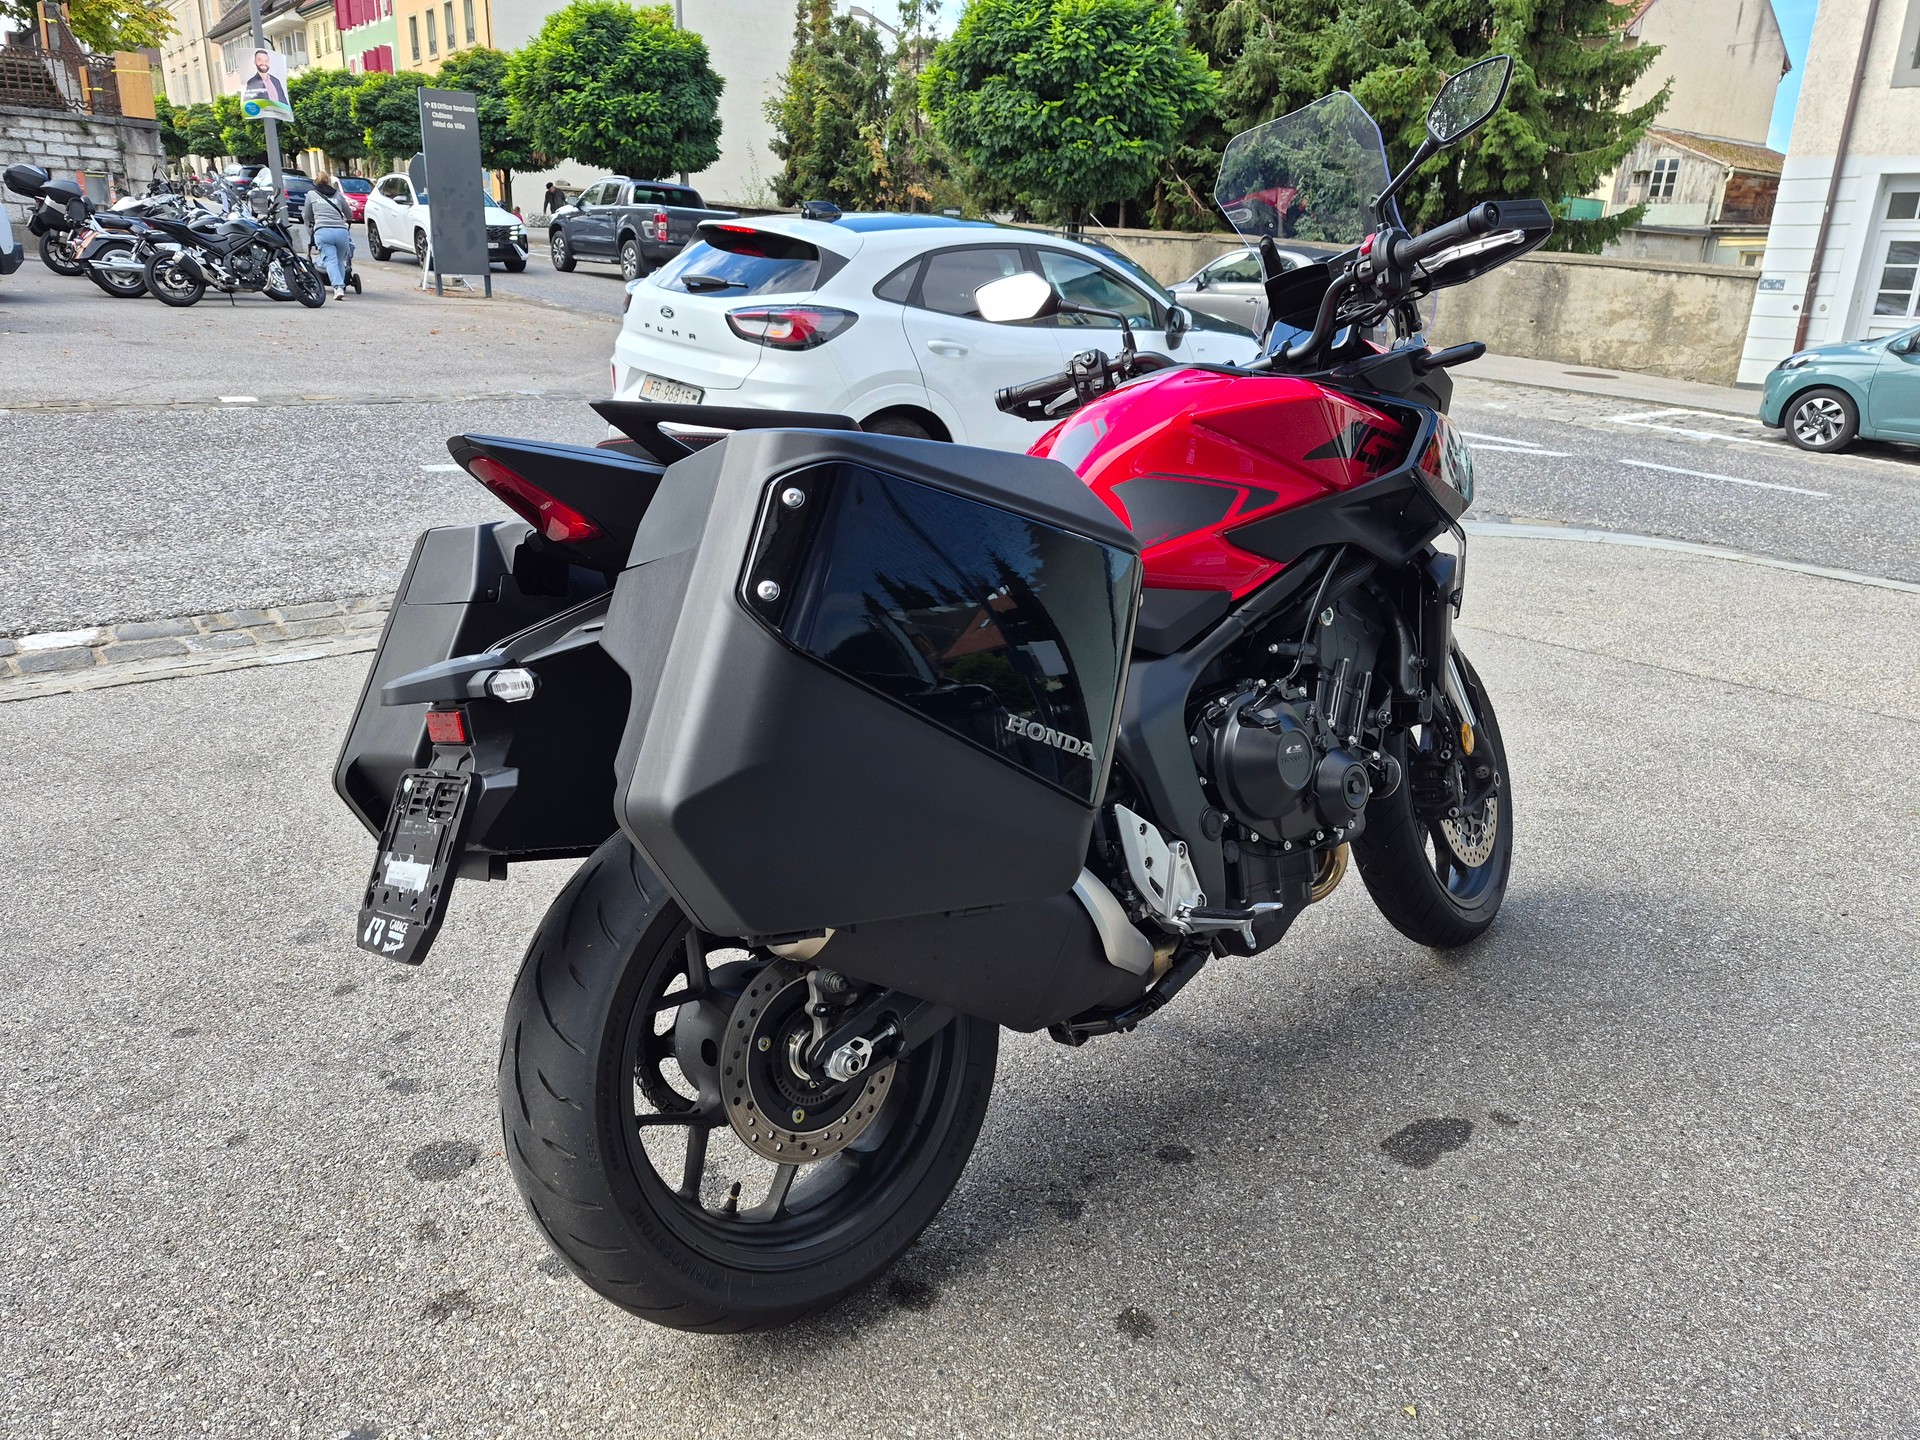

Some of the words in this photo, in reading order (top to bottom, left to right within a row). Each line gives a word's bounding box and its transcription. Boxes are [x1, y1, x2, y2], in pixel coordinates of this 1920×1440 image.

[453, 105, 475, 113] tourisme
[645, 322, 697, 340] PUMA
[1005, 713, 1096, 760] HONDA
